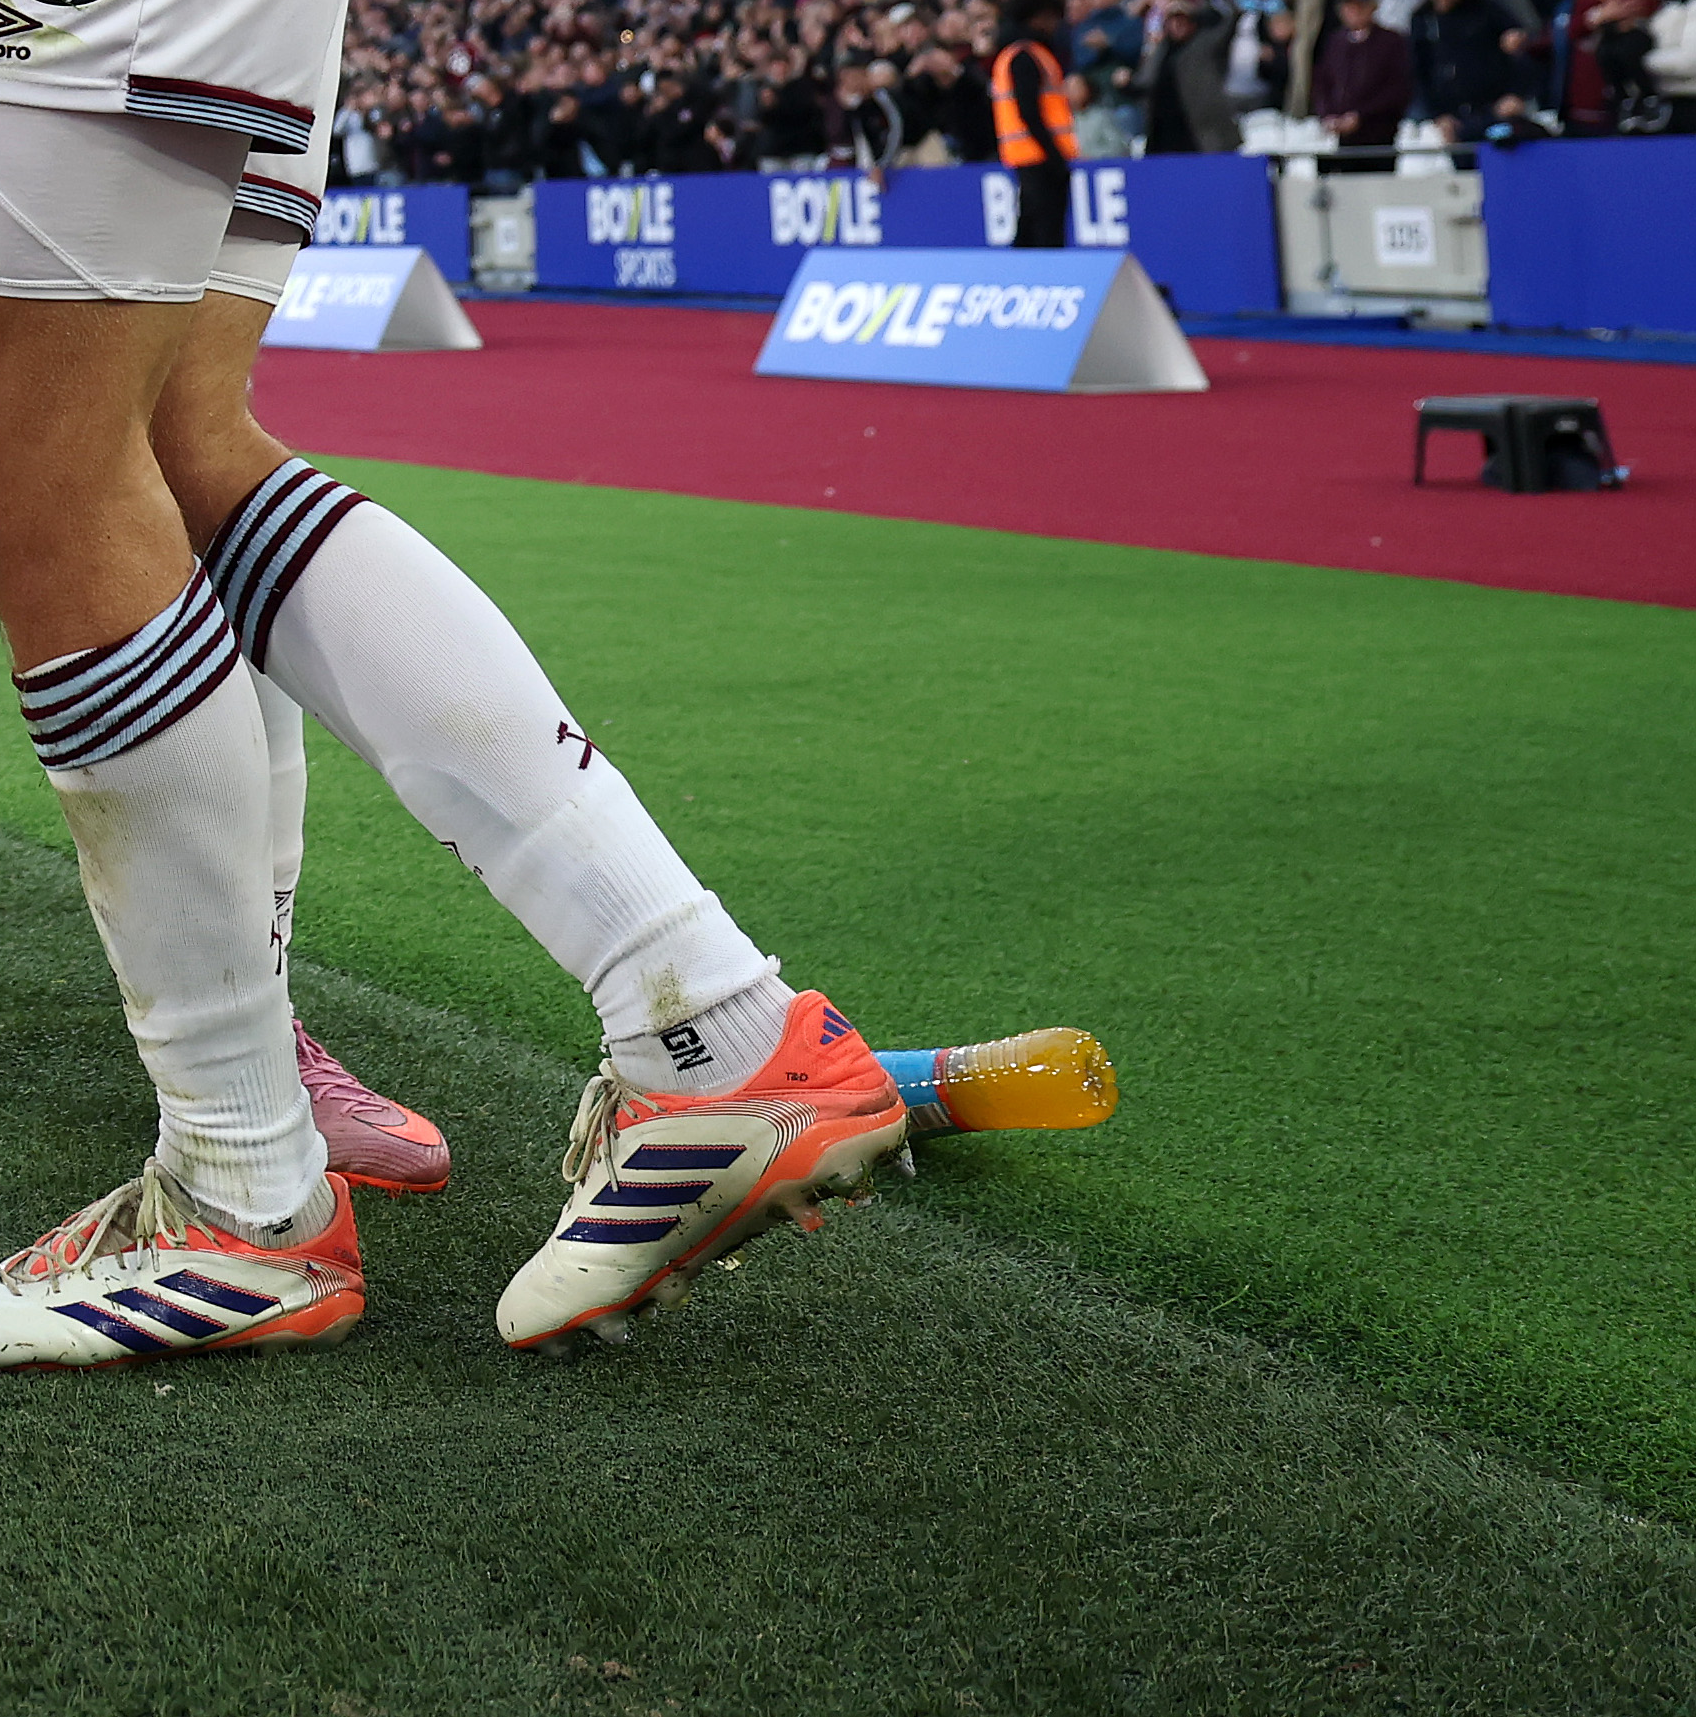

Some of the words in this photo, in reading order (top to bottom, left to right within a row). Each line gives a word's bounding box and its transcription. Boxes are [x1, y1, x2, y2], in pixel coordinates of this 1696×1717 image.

[585, 183, 675, 245] BOYLE
[769, 177, 883, 246] BOYLE
[981, 167, 1131, 247] BLE
[614, 247, 677, 289] SPORTS
[782, 281, 965, 347] BOYLE
[952, 283, 1086, 332] SPORTS
